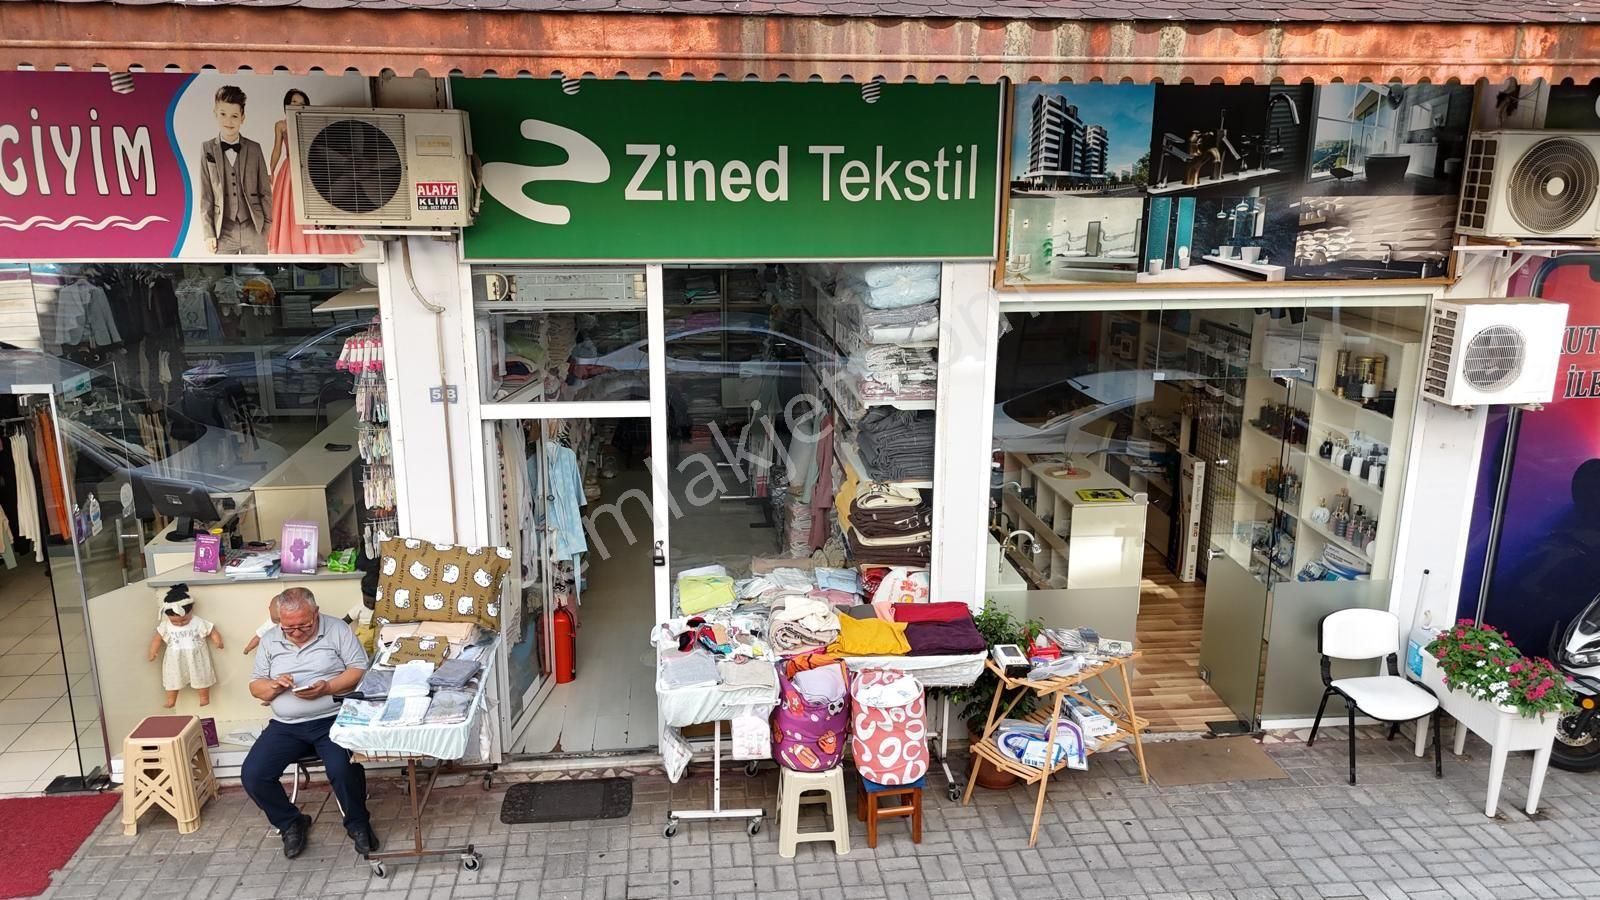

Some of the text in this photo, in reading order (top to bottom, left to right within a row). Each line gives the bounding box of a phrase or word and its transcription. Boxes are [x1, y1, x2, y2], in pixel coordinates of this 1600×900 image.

[0, 108, 156, 196] GİYİM
[417, 183, 457, 196] ALAİYE
[624, 143, 978, 202] Zined Tekstil
[419, 197, 457, 206] KLİMA
